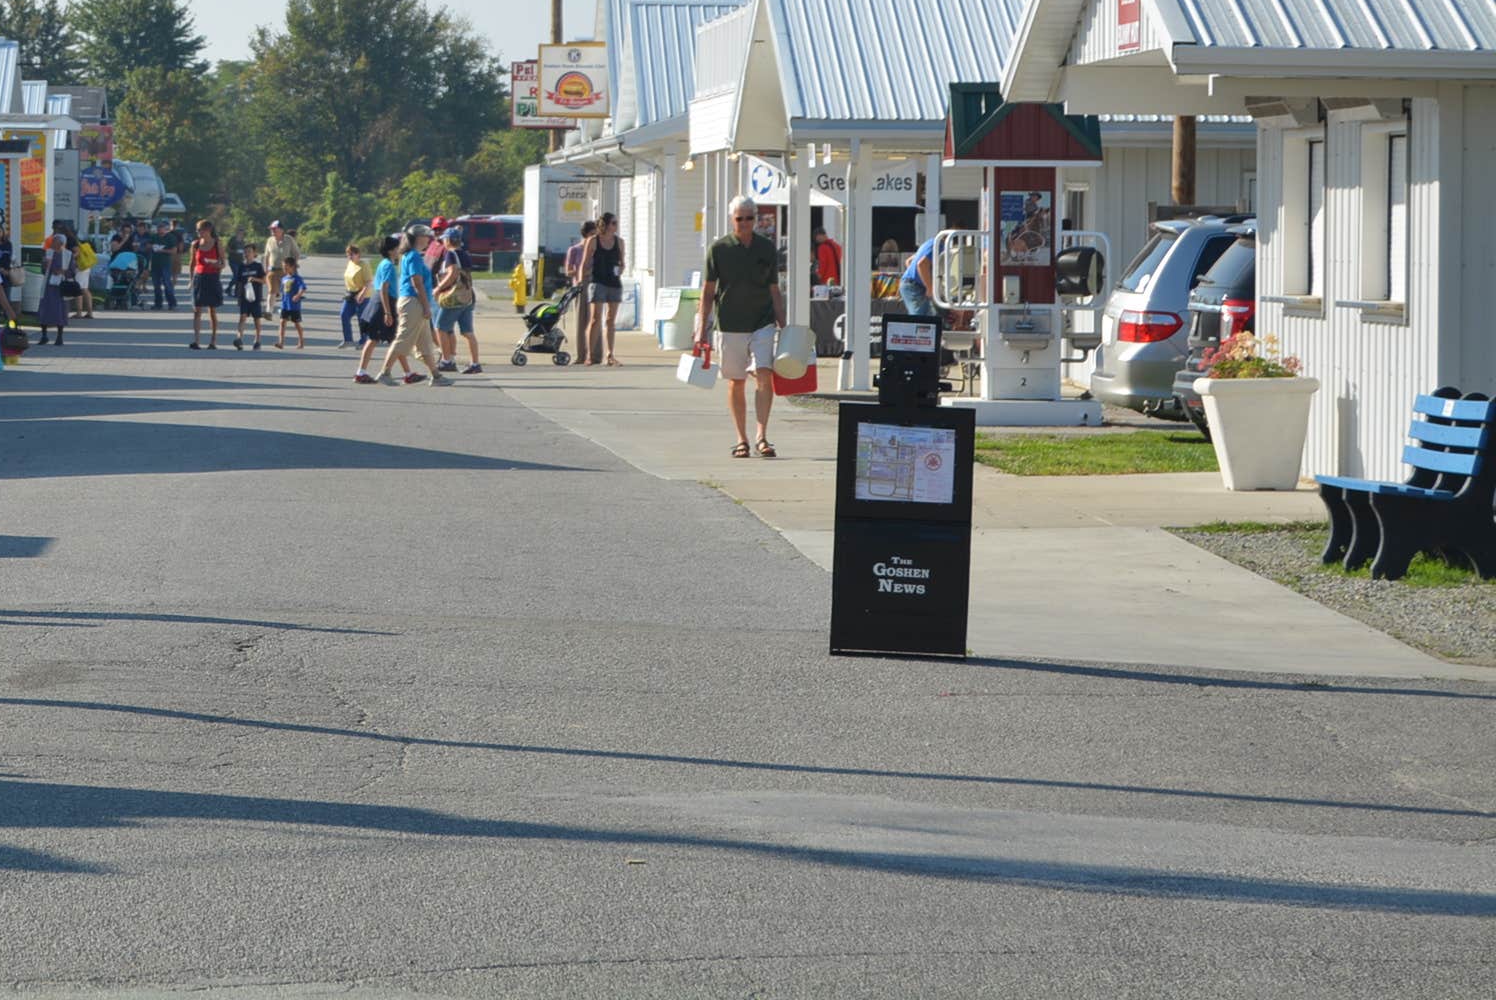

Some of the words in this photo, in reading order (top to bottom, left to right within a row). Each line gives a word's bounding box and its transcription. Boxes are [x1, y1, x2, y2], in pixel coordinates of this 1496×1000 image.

[817, 173, 849, 191] Gre
[1020, 377, 1027, 387] 2
[872, 562, 930, 579] GOSHEN
[877, 578, 926, 594] NEWS
